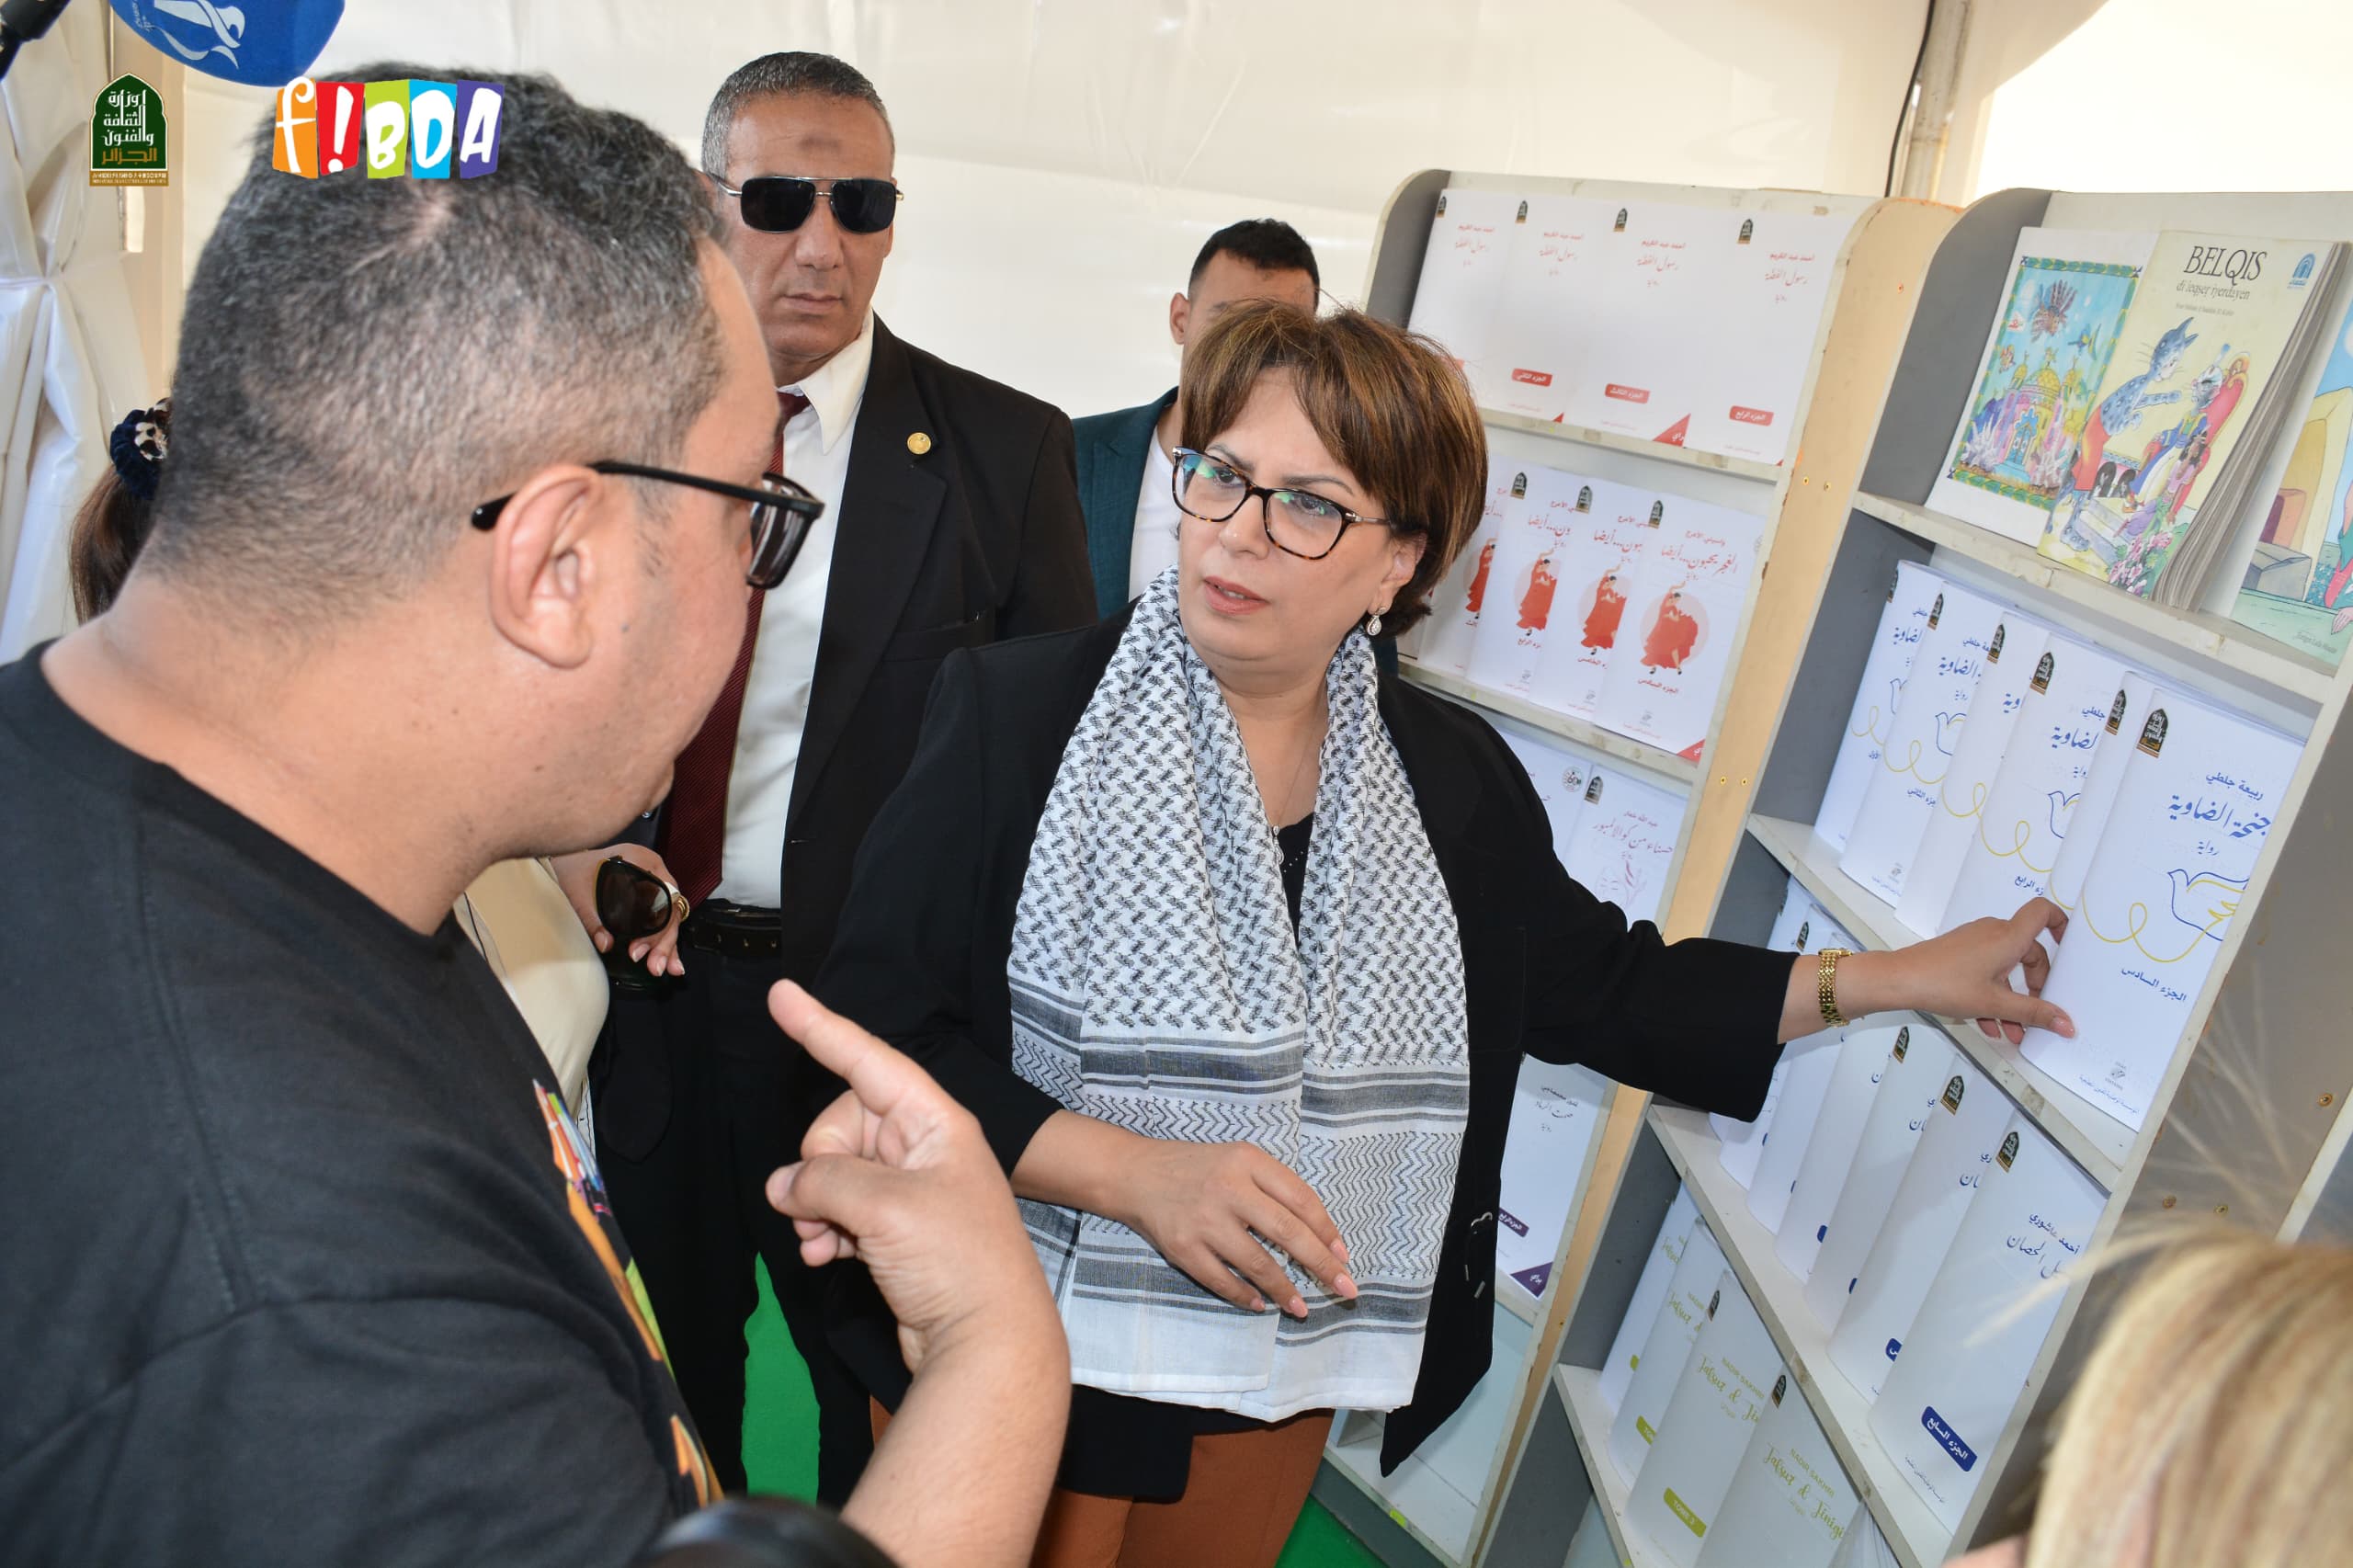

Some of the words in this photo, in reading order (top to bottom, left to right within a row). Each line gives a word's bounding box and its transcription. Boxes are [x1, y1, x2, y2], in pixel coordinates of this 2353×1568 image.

[2183, 245, 2268, 287] BELQIS
[1893, 627, 1924, 645] لضاوية
[2081, 706, 2106, 722] جلطي
[2051, 726, 2099, 750] لضاوية
[2206, 772, 2235, 790] جلطي
[2238, 779, 2264, 801] ربيعة
[2168, 794, 2234, 829] الضاوية
[2229, 812, 2271, 838] جنحة
[2196, 839, 2220, 856] رواية
[2014, 875, 2035, 889] الرابع
[2120, 968, 2160, 989] السادس
[2160, 986, 2188, 1003] الجزء
[2006, 1234, 2047, 1265] الحصان
[2058, 1237, 2081, 1256] أحمد
[1927, 1416, 1950, 1441] السابع
[1948, 1439, 1969, 1460] الجزء
